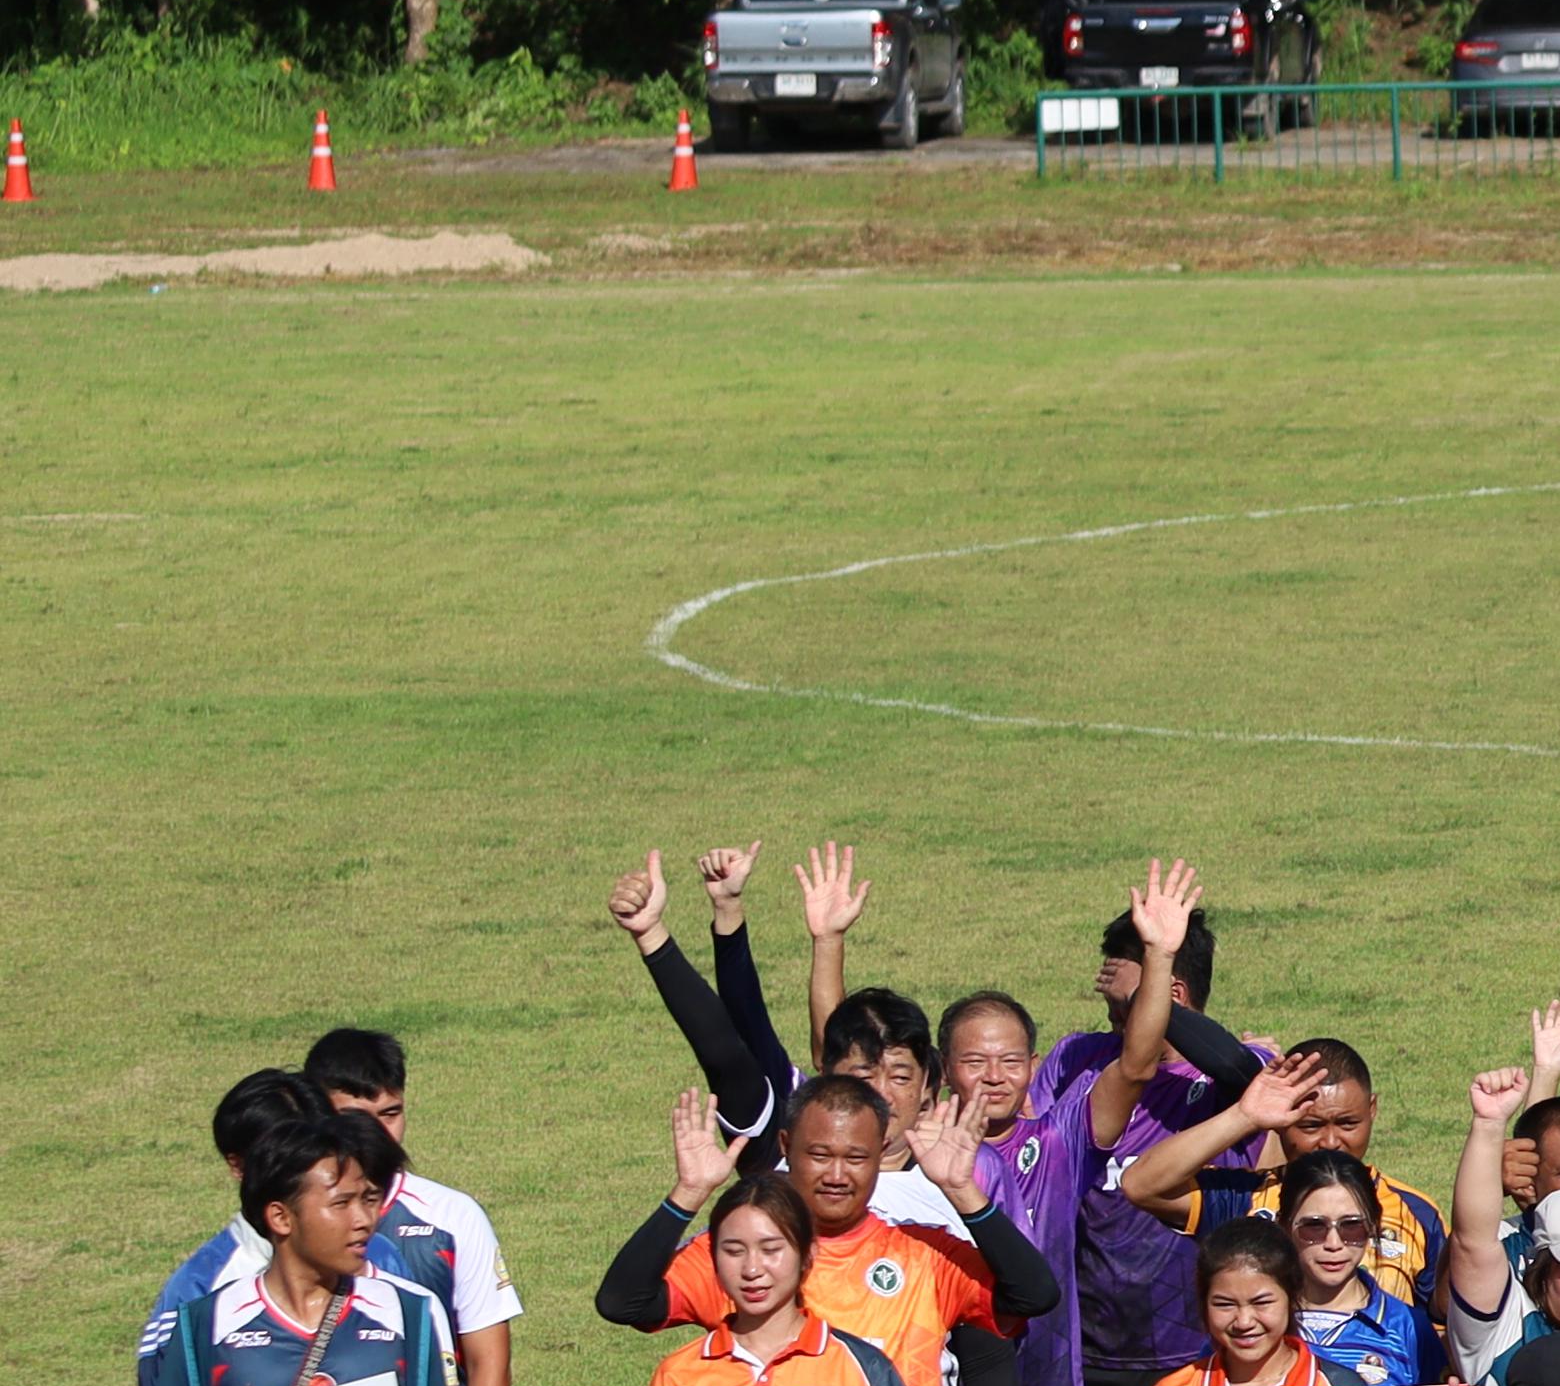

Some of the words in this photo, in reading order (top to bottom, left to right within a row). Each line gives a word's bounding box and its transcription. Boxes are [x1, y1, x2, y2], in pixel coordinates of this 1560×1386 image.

[397, 1225, 435, 1237] TSW
[225, 1330, 269, 1344] DCC
[358, 1329, 396, 1342] TSW
